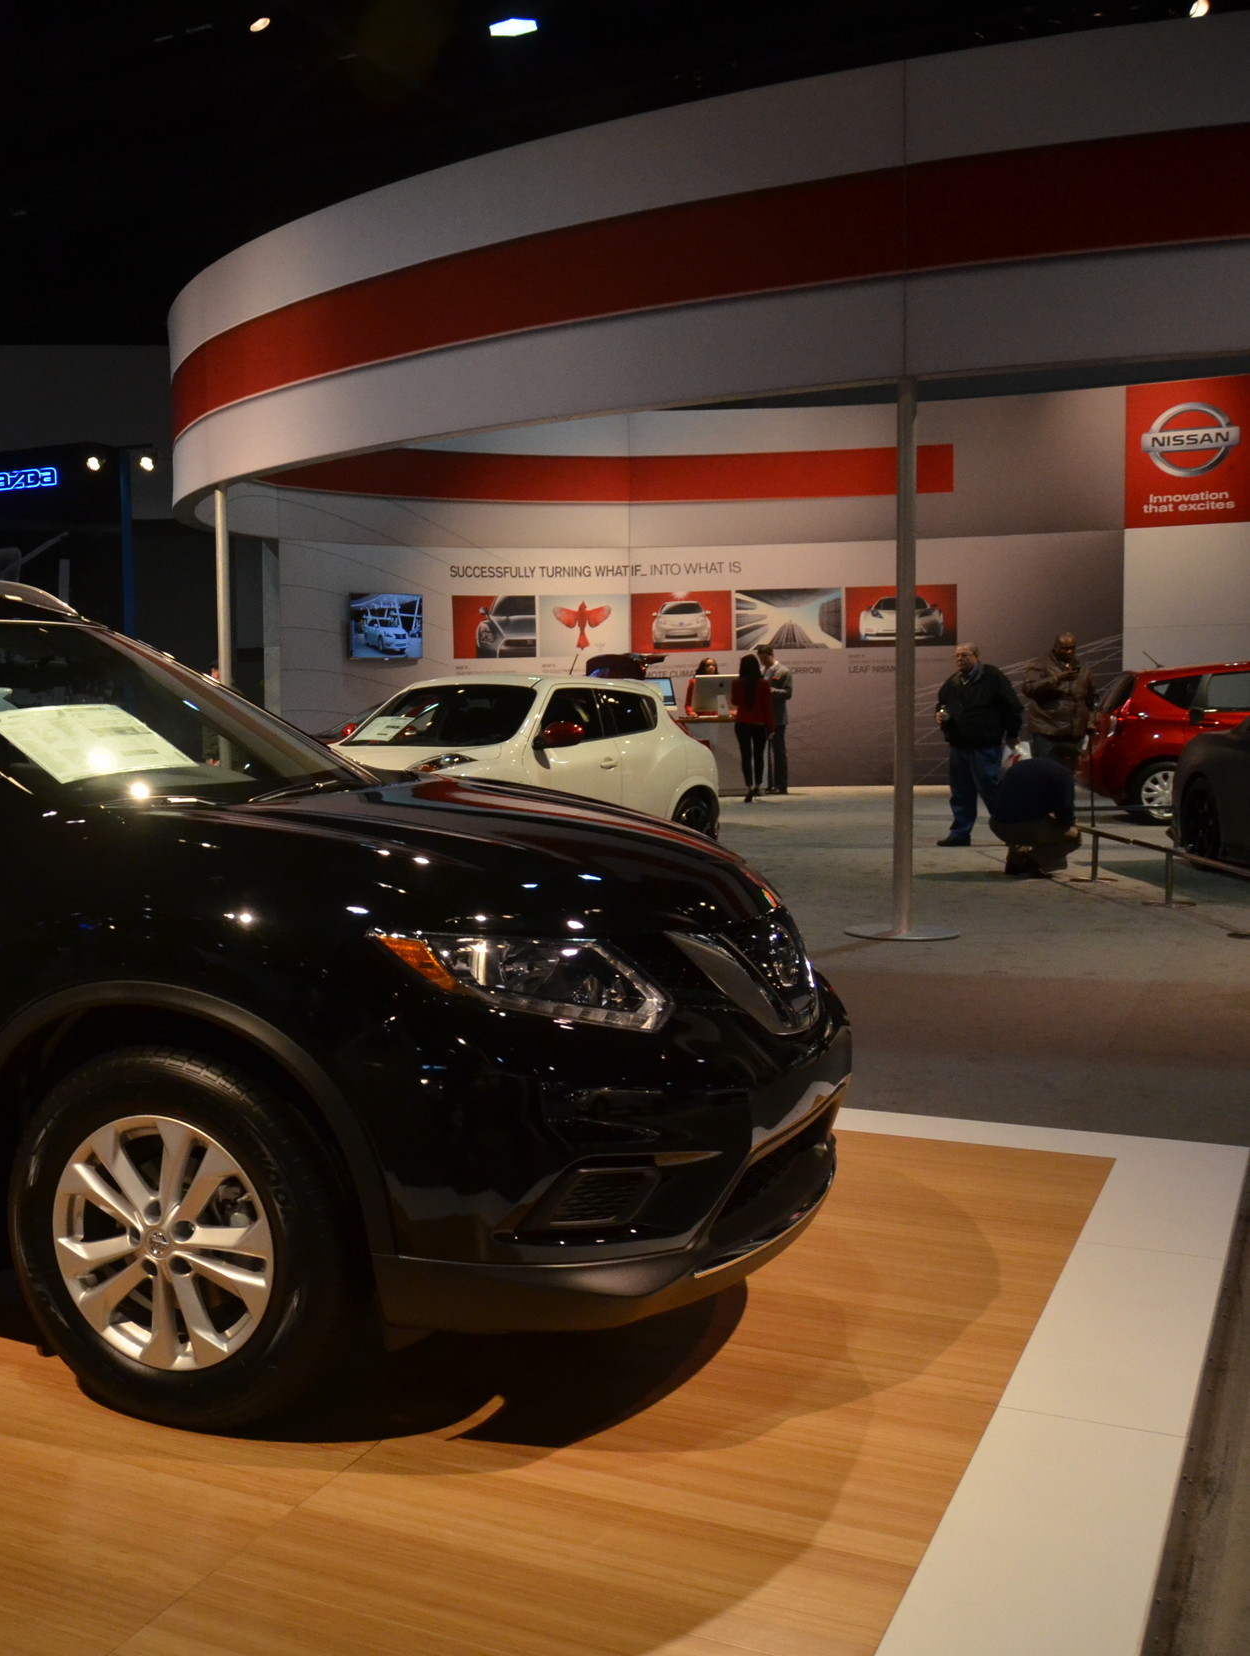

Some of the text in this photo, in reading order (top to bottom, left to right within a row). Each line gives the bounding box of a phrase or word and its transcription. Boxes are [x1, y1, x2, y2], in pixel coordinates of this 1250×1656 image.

[1151, 432, 1229, 447] NISSAN
[1149, 491, 1229, 503] Innovation
[1143, 500, 1235, 514] that excites
[450, 565, 536, 579] SUCCESSFULLY
[539, 565, 592, 578] TURNING
[650, 563, 681, 576] INTO
[684, 561, 725, 574] WHAT
[729, 560, 743, 574] IS
[848, 664, 870, 674] LEAF
